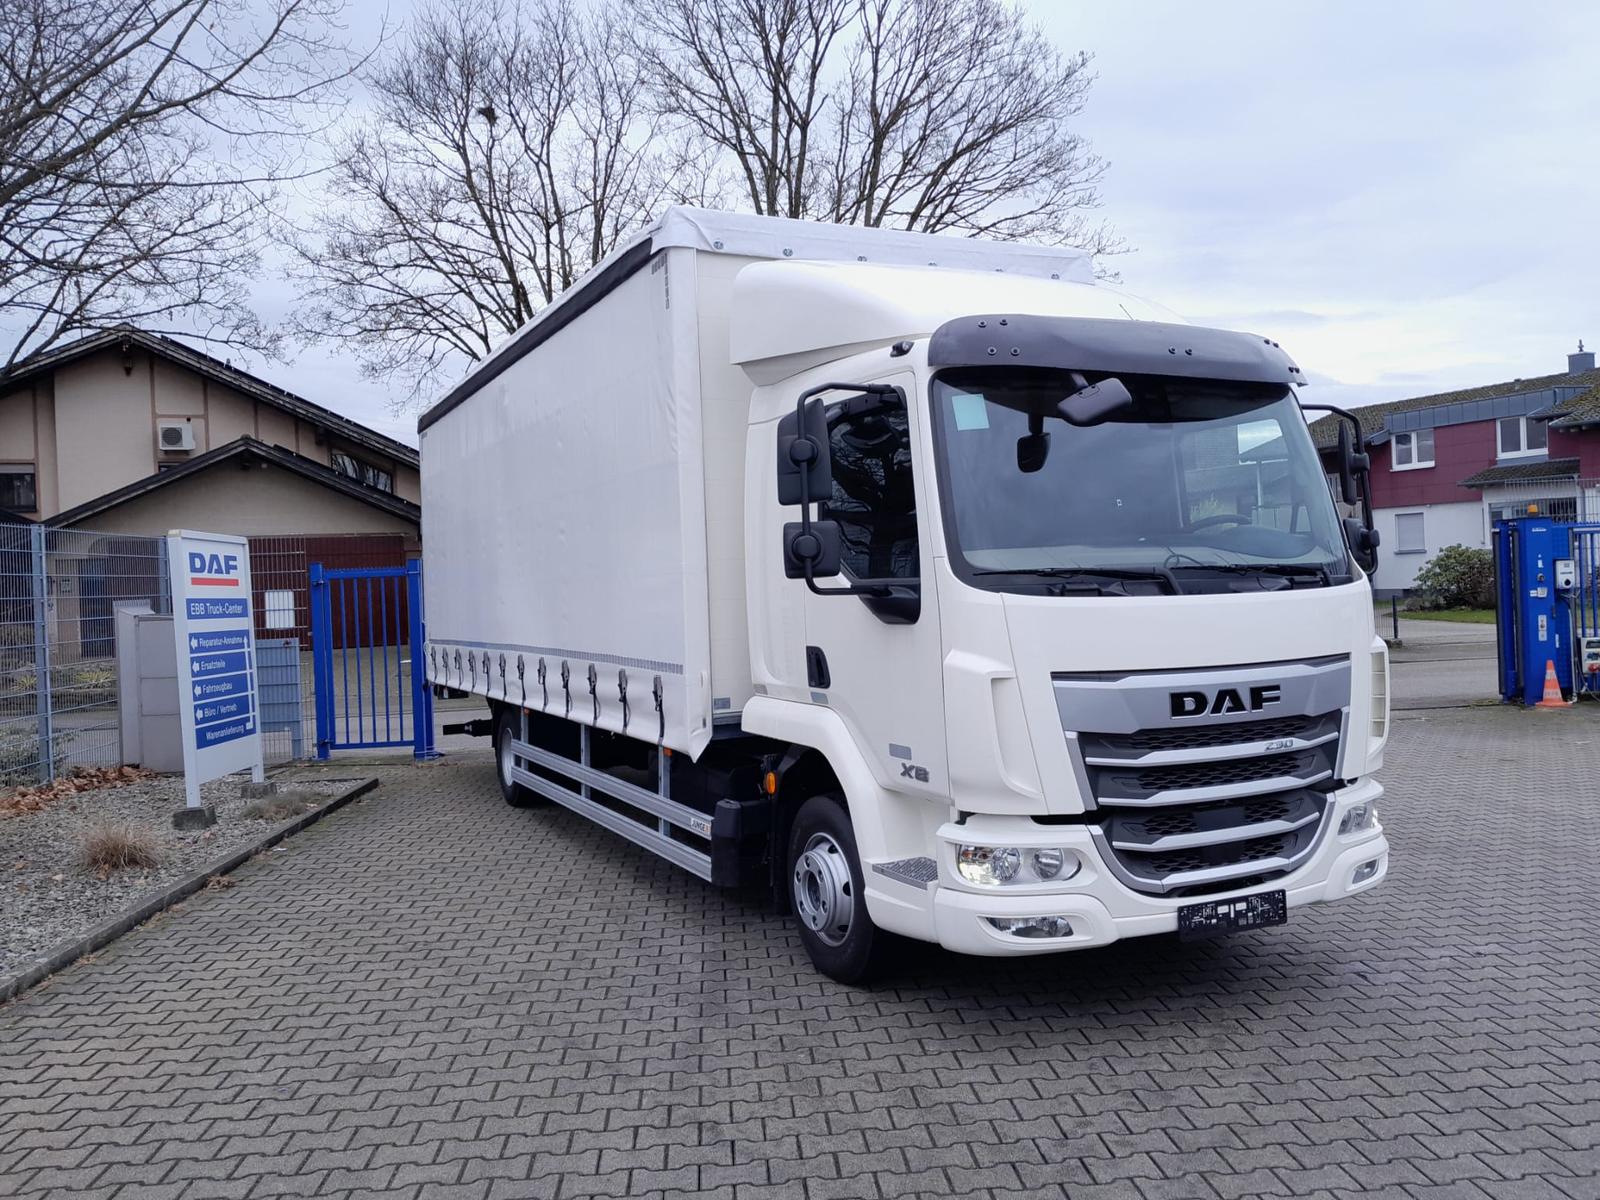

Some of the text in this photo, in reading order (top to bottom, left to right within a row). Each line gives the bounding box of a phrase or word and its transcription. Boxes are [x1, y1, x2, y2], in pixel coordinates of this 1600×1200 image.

[188, 552, 238, 574] DAF
[190, 602, 243, 615] EBB Truck-Center
[200, 659, 226, 671] Ersatzteile
[202, 682, 233, 693] Fahrzeugbau
[1169, 684, 1281, 719] DAF
[204, 708, 216, 718] Büro
[220, 703, 238, 715] Vertrieb
[206, 724, 245, 740] Warenanlieferung
